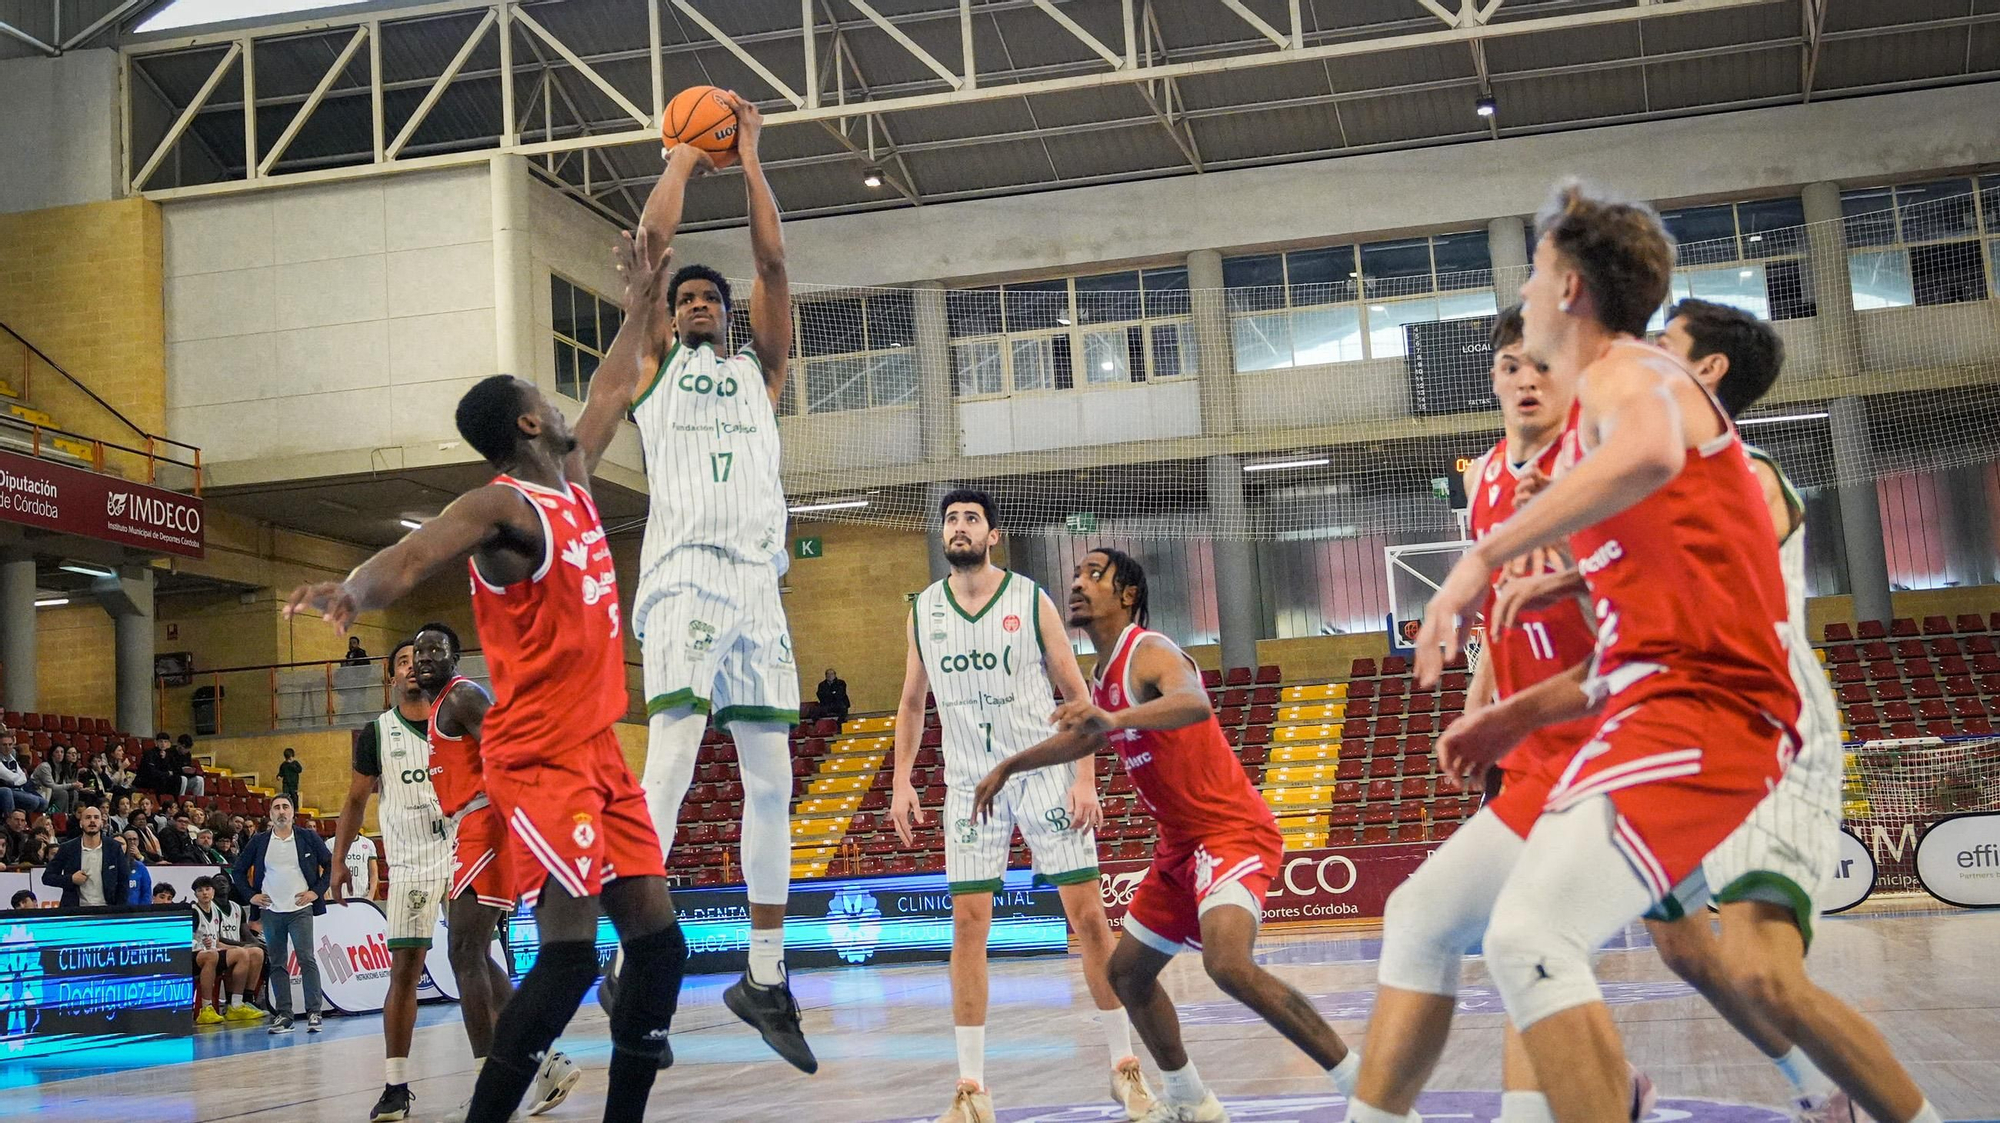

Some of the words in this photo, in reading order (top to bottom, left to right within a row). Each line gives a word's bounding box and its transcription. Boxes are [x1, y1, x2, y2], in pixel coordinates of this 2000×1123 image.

[710, 451, 733, 483] 17
[13, 493, 59, 519] Córdoba
[129, 493, 200, 534] IMDECO
[107, 520, 128, 533] Instituto
[128, 525, 152, 538] Municipal
[152, 531, 159, 540] de
[159, 532, 181, 544] Deportes
[802, 540, 814, 556] K
[1522, 621, 1554, 660] 11
[940, 649, 998, 673] coto
[978, 722, 992, 753] 7
[694, 906, 747, 922] DENTA
[1303, 903, 1358, 916] Córdoba
